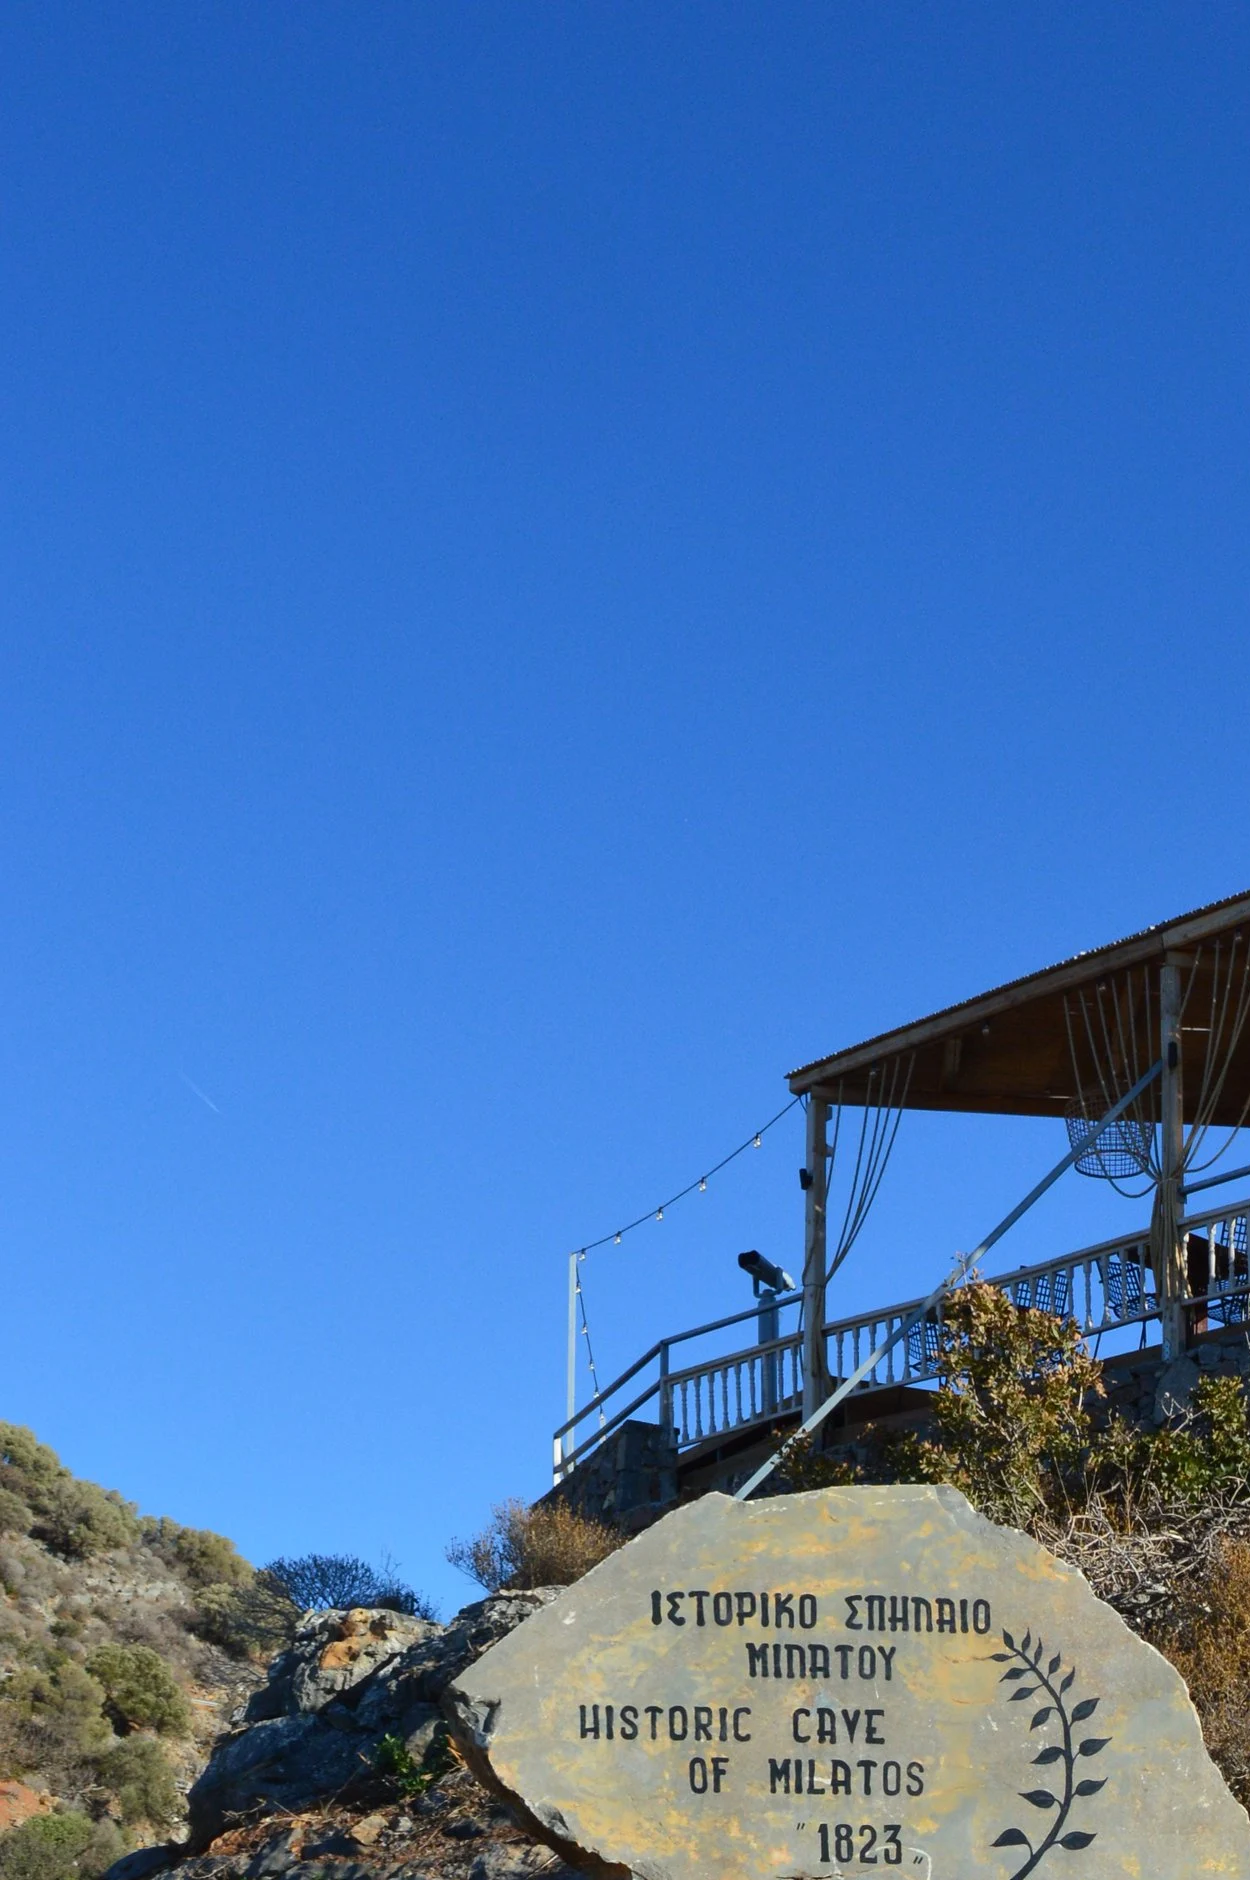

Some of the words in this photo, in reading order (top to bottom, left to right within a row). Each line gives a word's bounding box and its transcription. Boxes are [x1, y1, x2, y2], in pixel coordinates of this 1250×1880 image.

[651, 1590, 818, 1629] ΙΣΤΟΡΙΚΟ
[844, 1594, 991, 1634] ΣΠΗΛΑΙΟ
[745, 1643, 897, 1681] ΜΙΛΑΤΟΥ
[579, 1704, 752, 1742] HISTORIC
[792, 1707, 885, 1745] CAVE
[689, 1757, 730, 1794] OF
[768, 1758, 924, 1796] MILATOS
